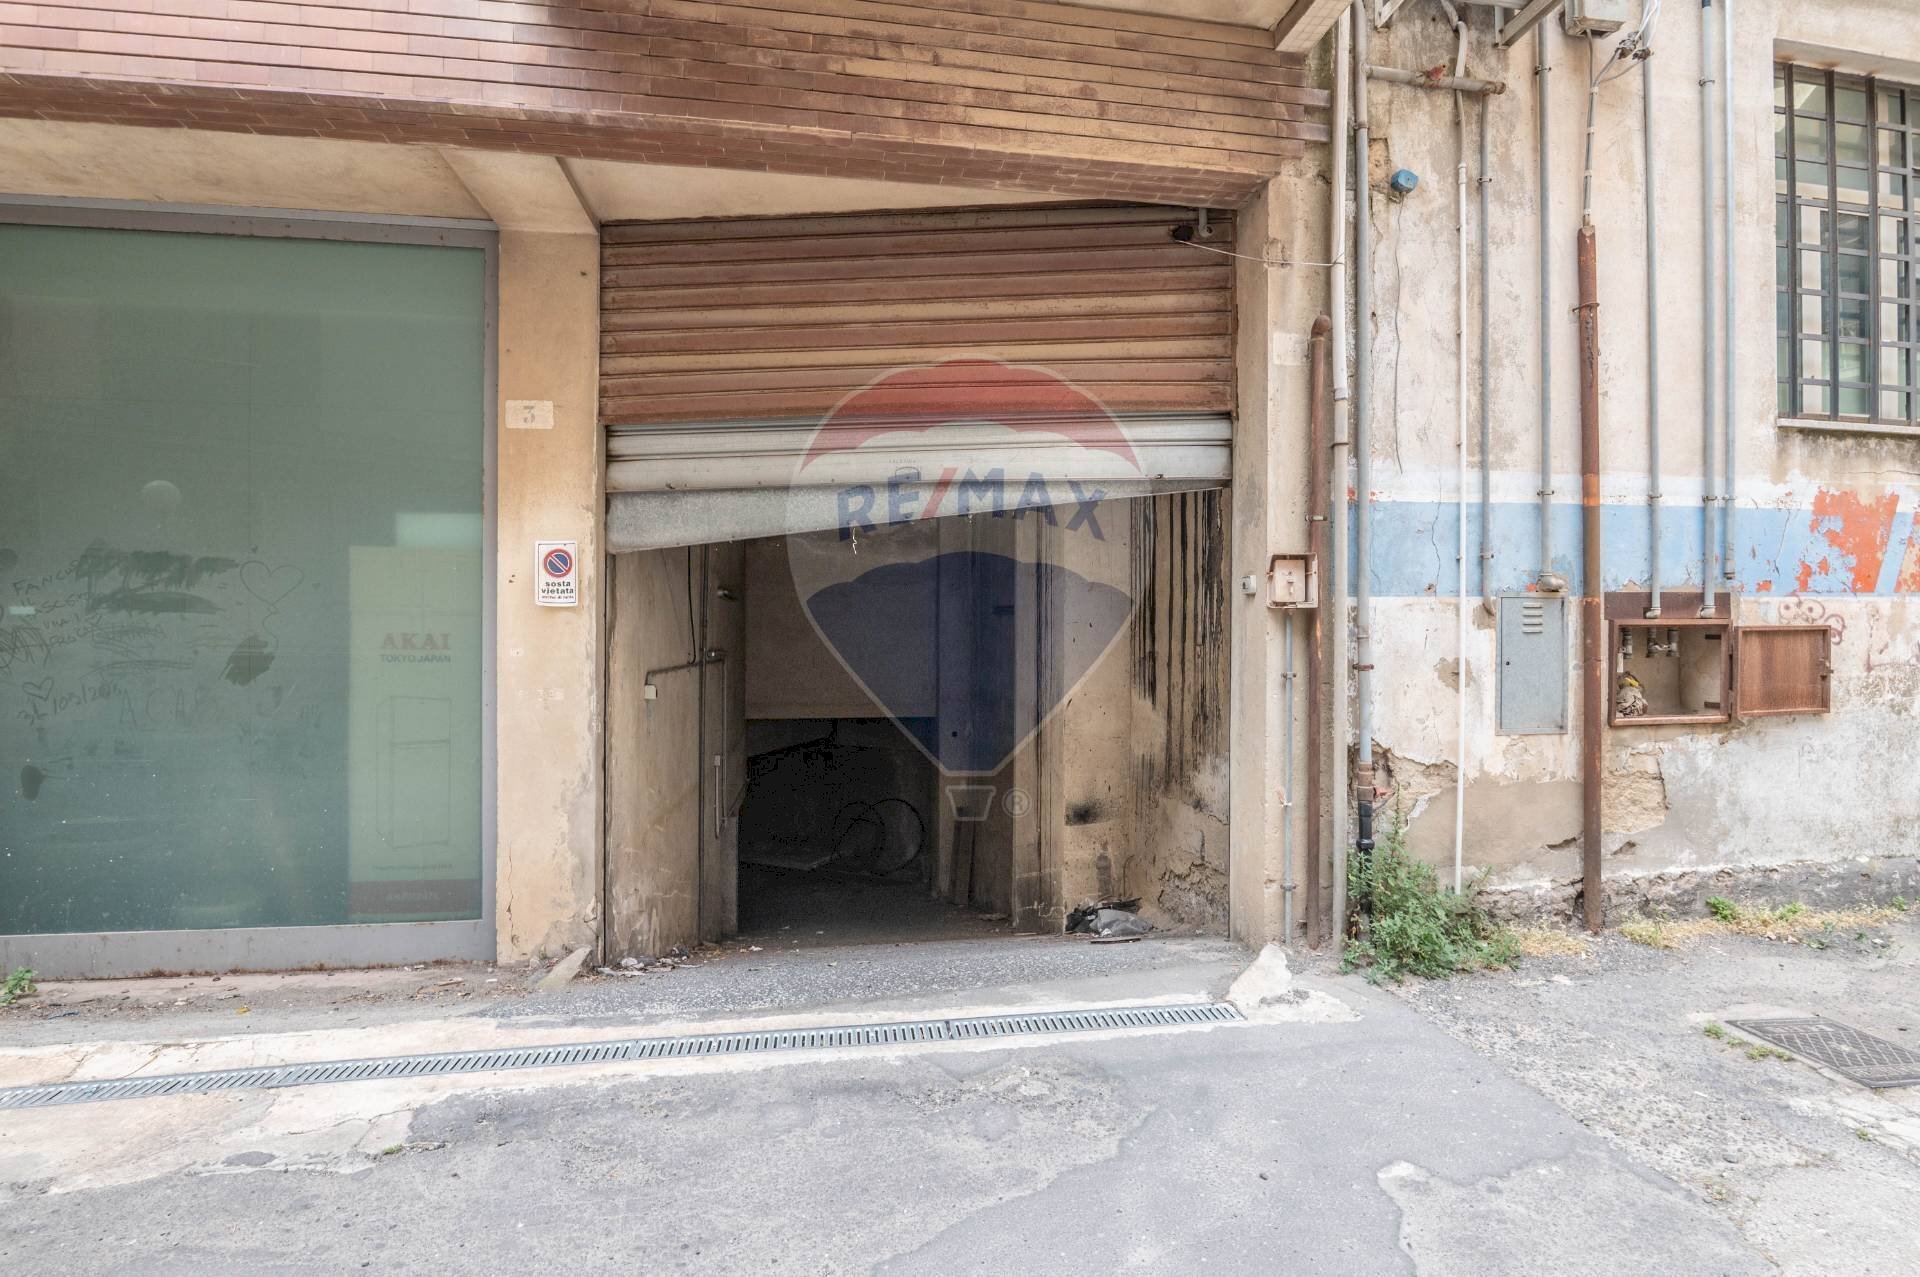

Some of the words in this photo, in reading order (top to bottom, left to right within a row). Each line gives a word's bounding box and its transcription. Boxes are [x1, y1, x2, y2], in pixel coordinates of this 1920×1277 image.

[380, 632, 451, 650] AKAI
[381, 654, 416, 664] TOKYO
[417, 654, 452, 664] JAPAN
